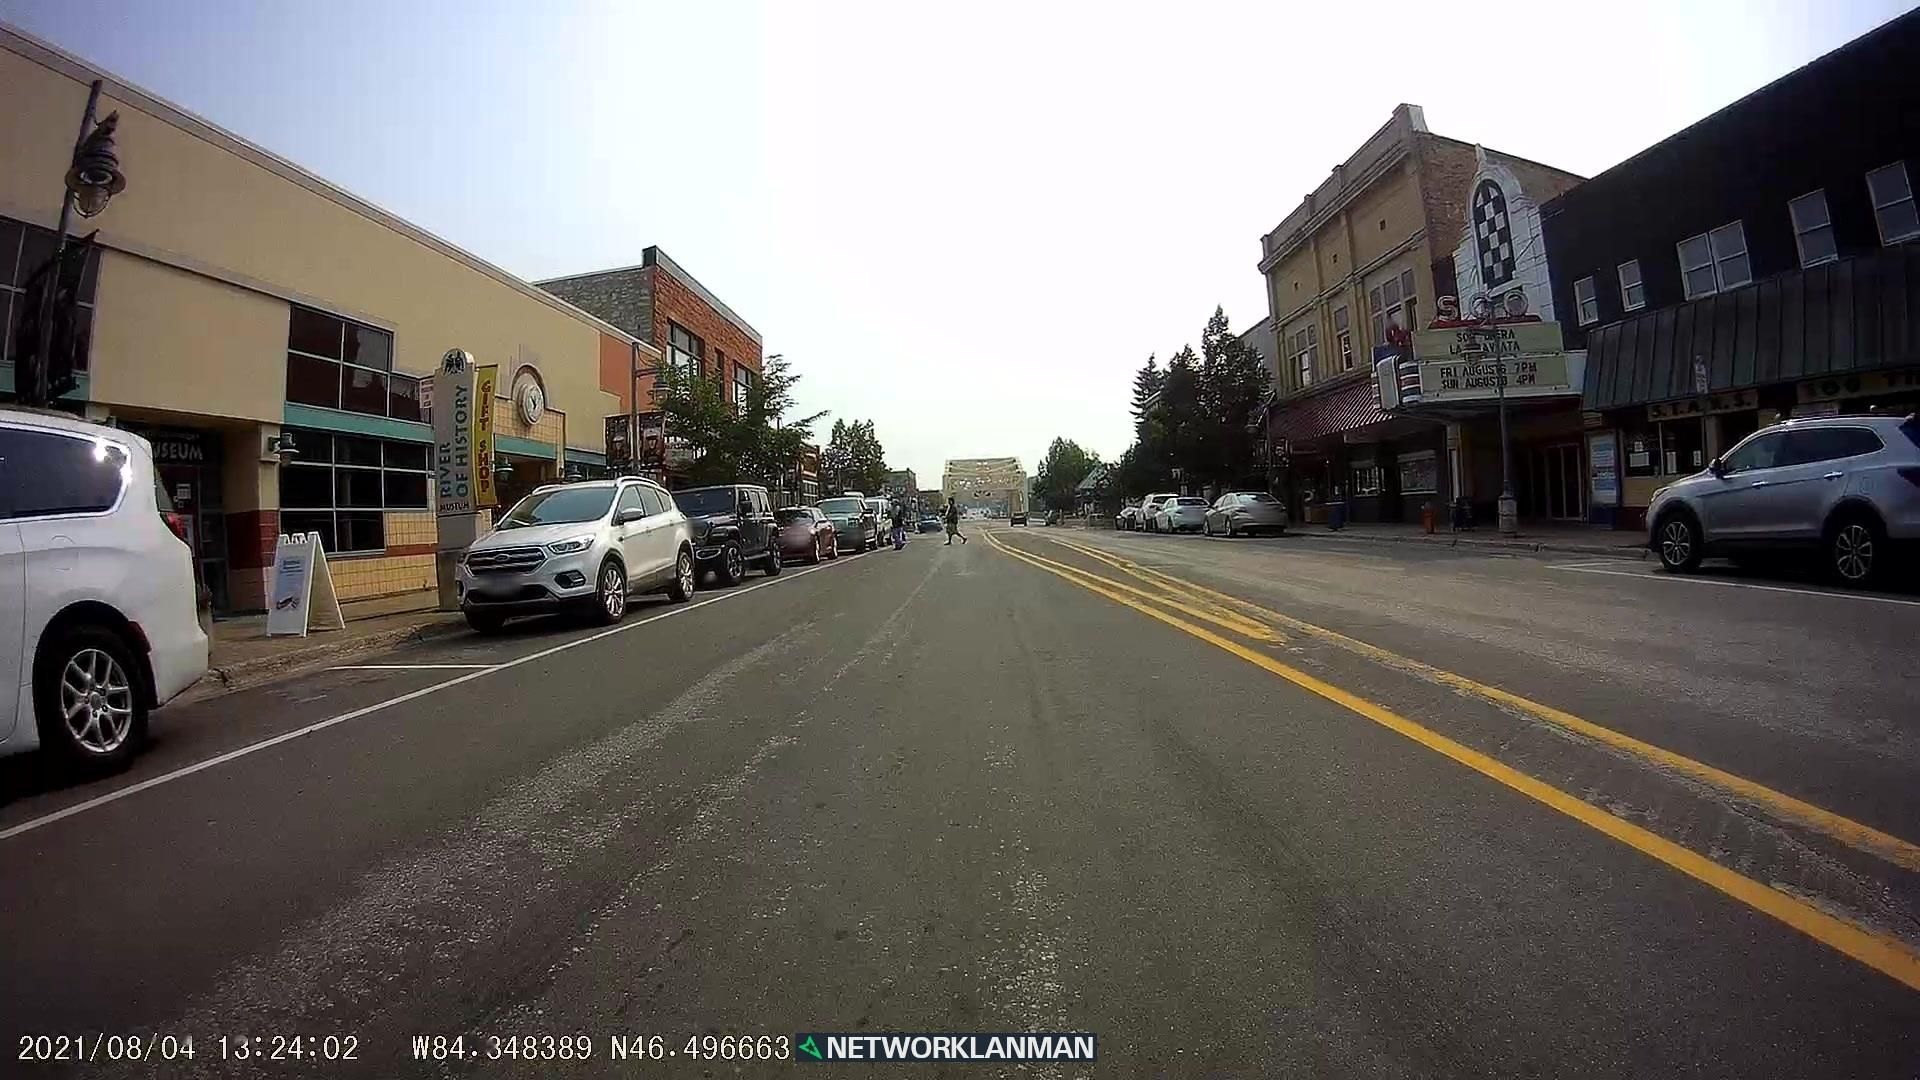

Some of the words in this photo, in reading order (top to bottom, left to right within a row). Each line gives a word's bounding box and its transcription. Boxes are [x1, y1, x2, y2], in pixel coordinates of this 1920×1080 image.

[1449, 344, 1462, 355] LA
[1440, 367, 1458, 378] FRI
[1514, 361, 1538, 373] 7PM
[1442, 378, 1459, 390] SUN
[1515, 373, 1537, 385] 4PM
[478, 379, 491, 431] GIFT
[455, 385, 468, 467] HISTORY
[152, 441, 204, 460] USEUM
[439, 441, 451, 498] RIVER
[478, 440, 490, 493] SHOP
[455, 472, 469, 497] OF
